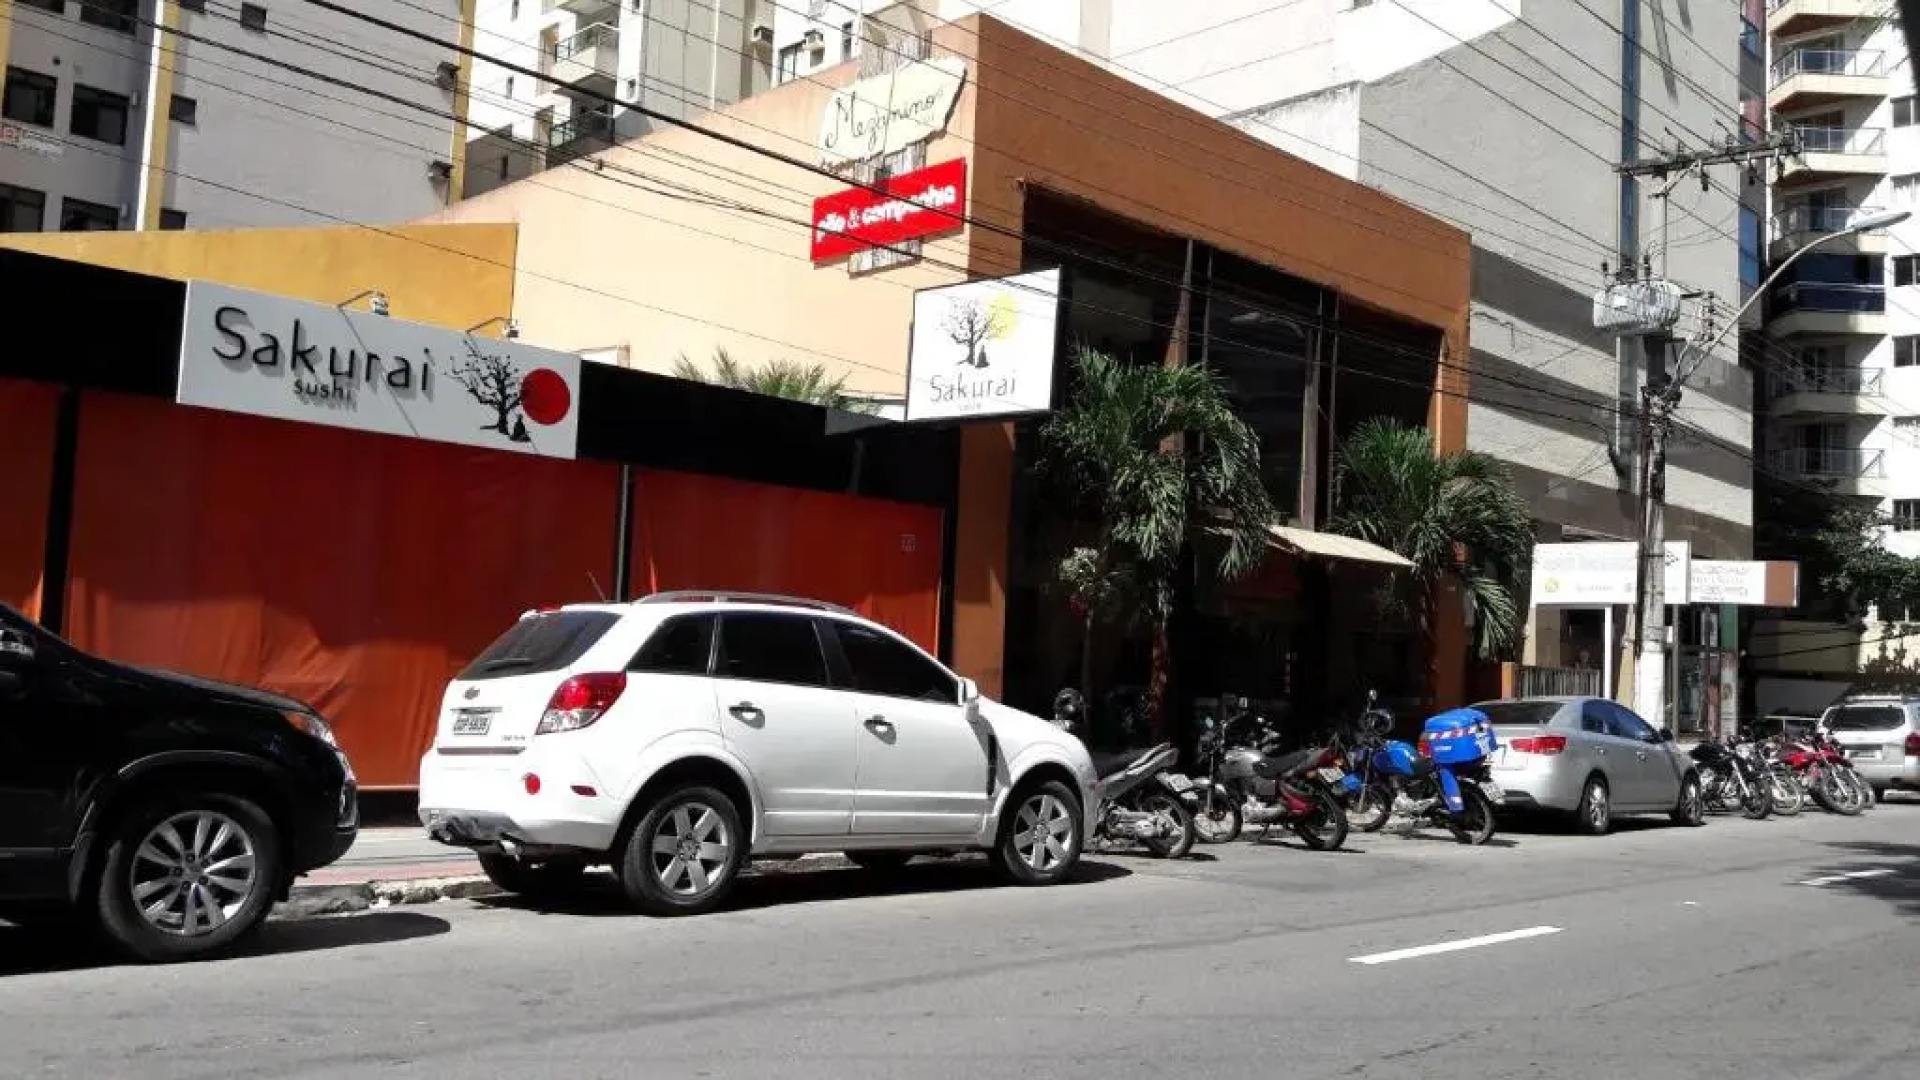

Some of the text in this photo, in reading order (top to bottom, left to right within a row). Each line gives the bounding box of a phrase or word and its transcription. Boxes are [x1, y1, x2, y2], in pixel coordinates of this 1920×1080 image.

[212, 305, 431, 392] Sakurai
[294, 379, 354, 401] sushi
[929, 369, 1016, 403] Sakurai
